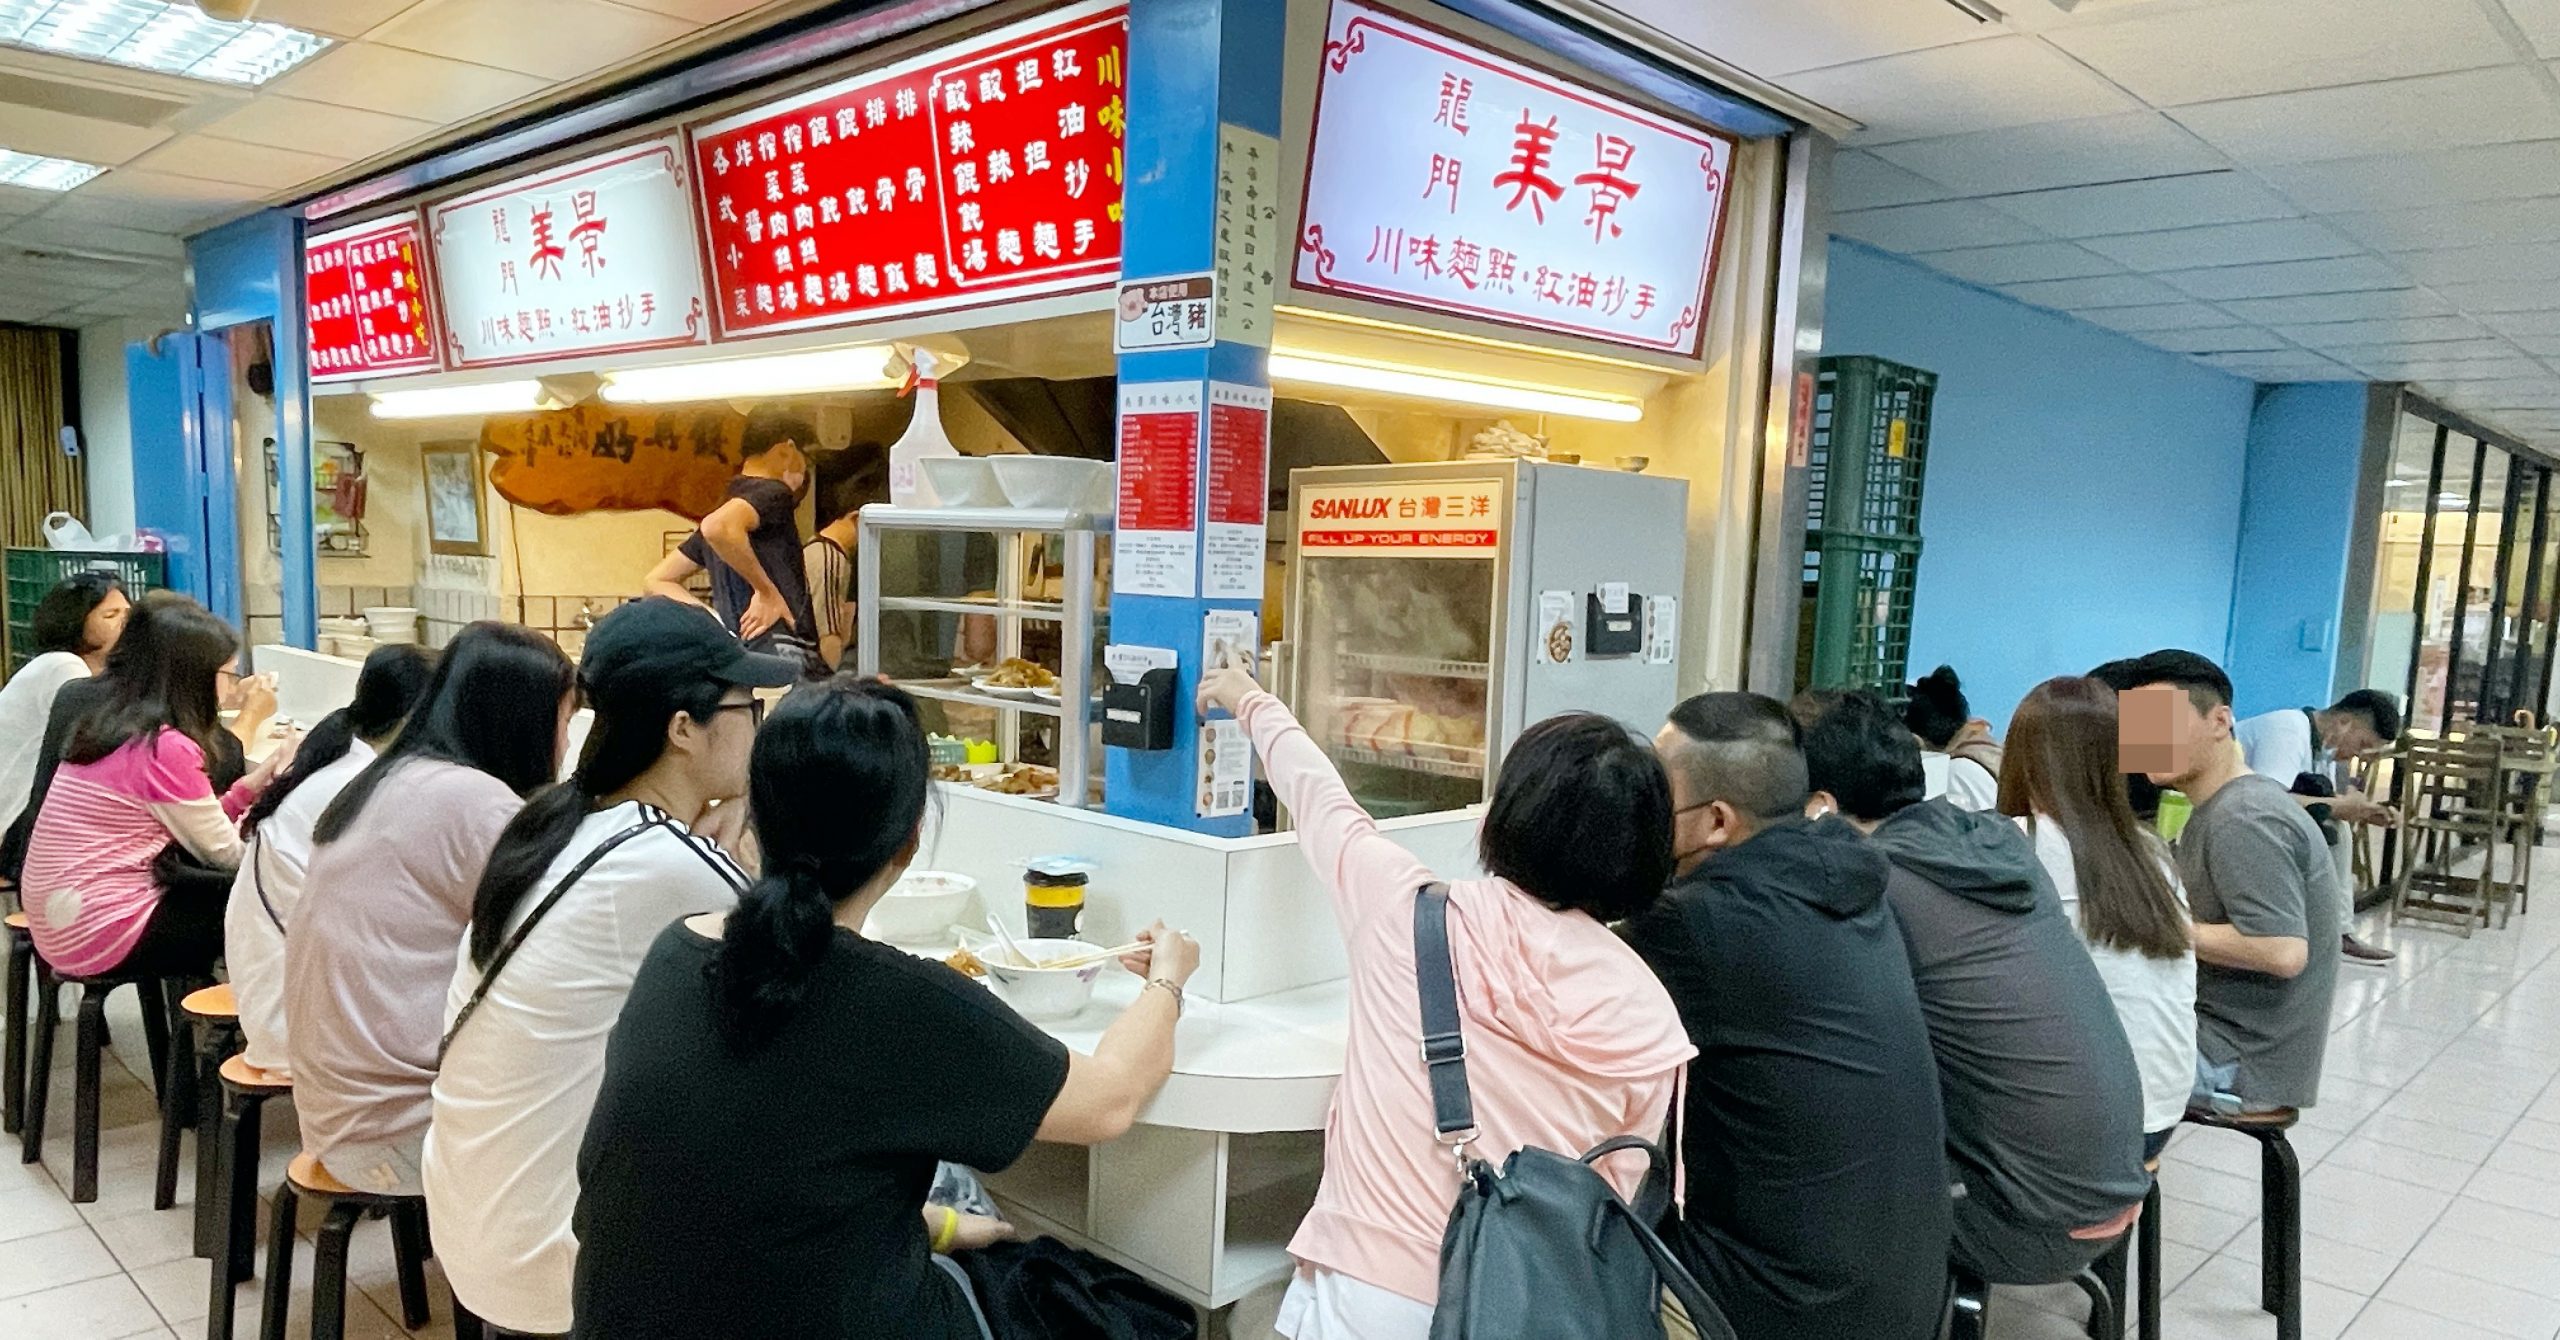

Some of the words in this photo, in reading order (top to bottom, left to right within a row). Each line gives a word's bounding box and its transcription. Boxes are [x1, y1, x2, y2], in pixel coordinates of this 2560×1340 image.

[712, 146, 751, 317] 各式小菜
[757, 131, 799, 311] 榨菜肉絲湯
[783, 123, 826, 307] 榨菜肉絲麵
[808, 116, 851, 303] 餛飩湯
[836, 107, 880, 298] 餛飩麵
[866, 96, 910, 294] 排骨飯
[896, 87, 940, 288] 排骨麵
[979, 68, 1024, 266] 酸辣麵
[1016, 58, 1061, 260] 担担麵
[1052, 49, 1095, 255] 紅油抄手
[1422, 71, 1475, 215] 龍門
[1493, 107, 1642, 245] 美景
[491, 208, 519, 295] 龍門
[529, 190, 608, 281] 美景
[1151, 301, 1206, 338] 台灣豬
[1308, 534, 1339, 544] FILL
[1343, 534, 1365, 543] UP
[1369, 533, 1413, 544] YOUR
[1418, 533, 1489, 544] ENERGY
[1310, 497, 1392, 519] SANLUX
[1399, 495, 1490, 518] 台灣三洋
